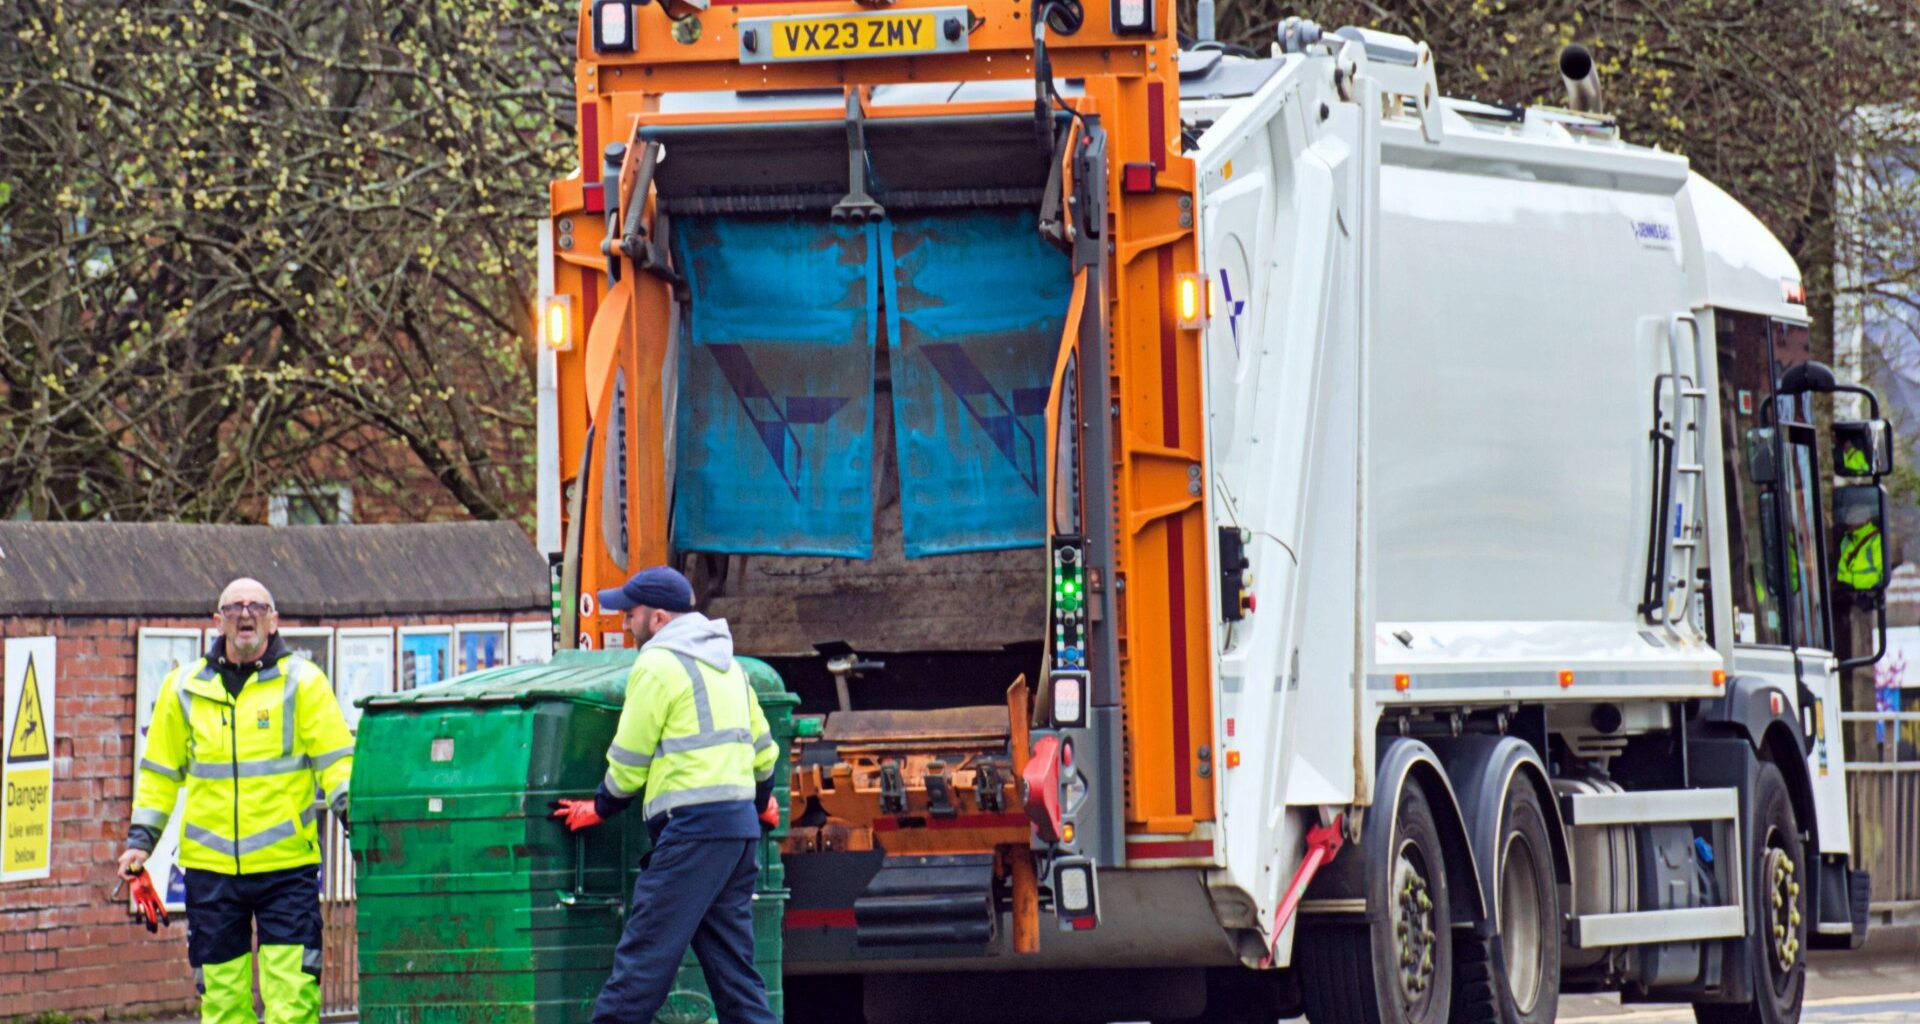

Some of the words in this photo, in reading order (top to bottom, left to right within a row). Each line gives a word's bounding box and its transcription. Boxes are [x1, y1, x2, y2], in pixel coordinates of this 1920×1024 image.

[784, 21, 859, 52] VX23
[867, 18, 923, 48] ZMY
[7, 781, 48, 812] Danger
[9, 822, 24, 839] Live
[25, 823, 44, 837] wires
[14, 848, 36, 864] below
